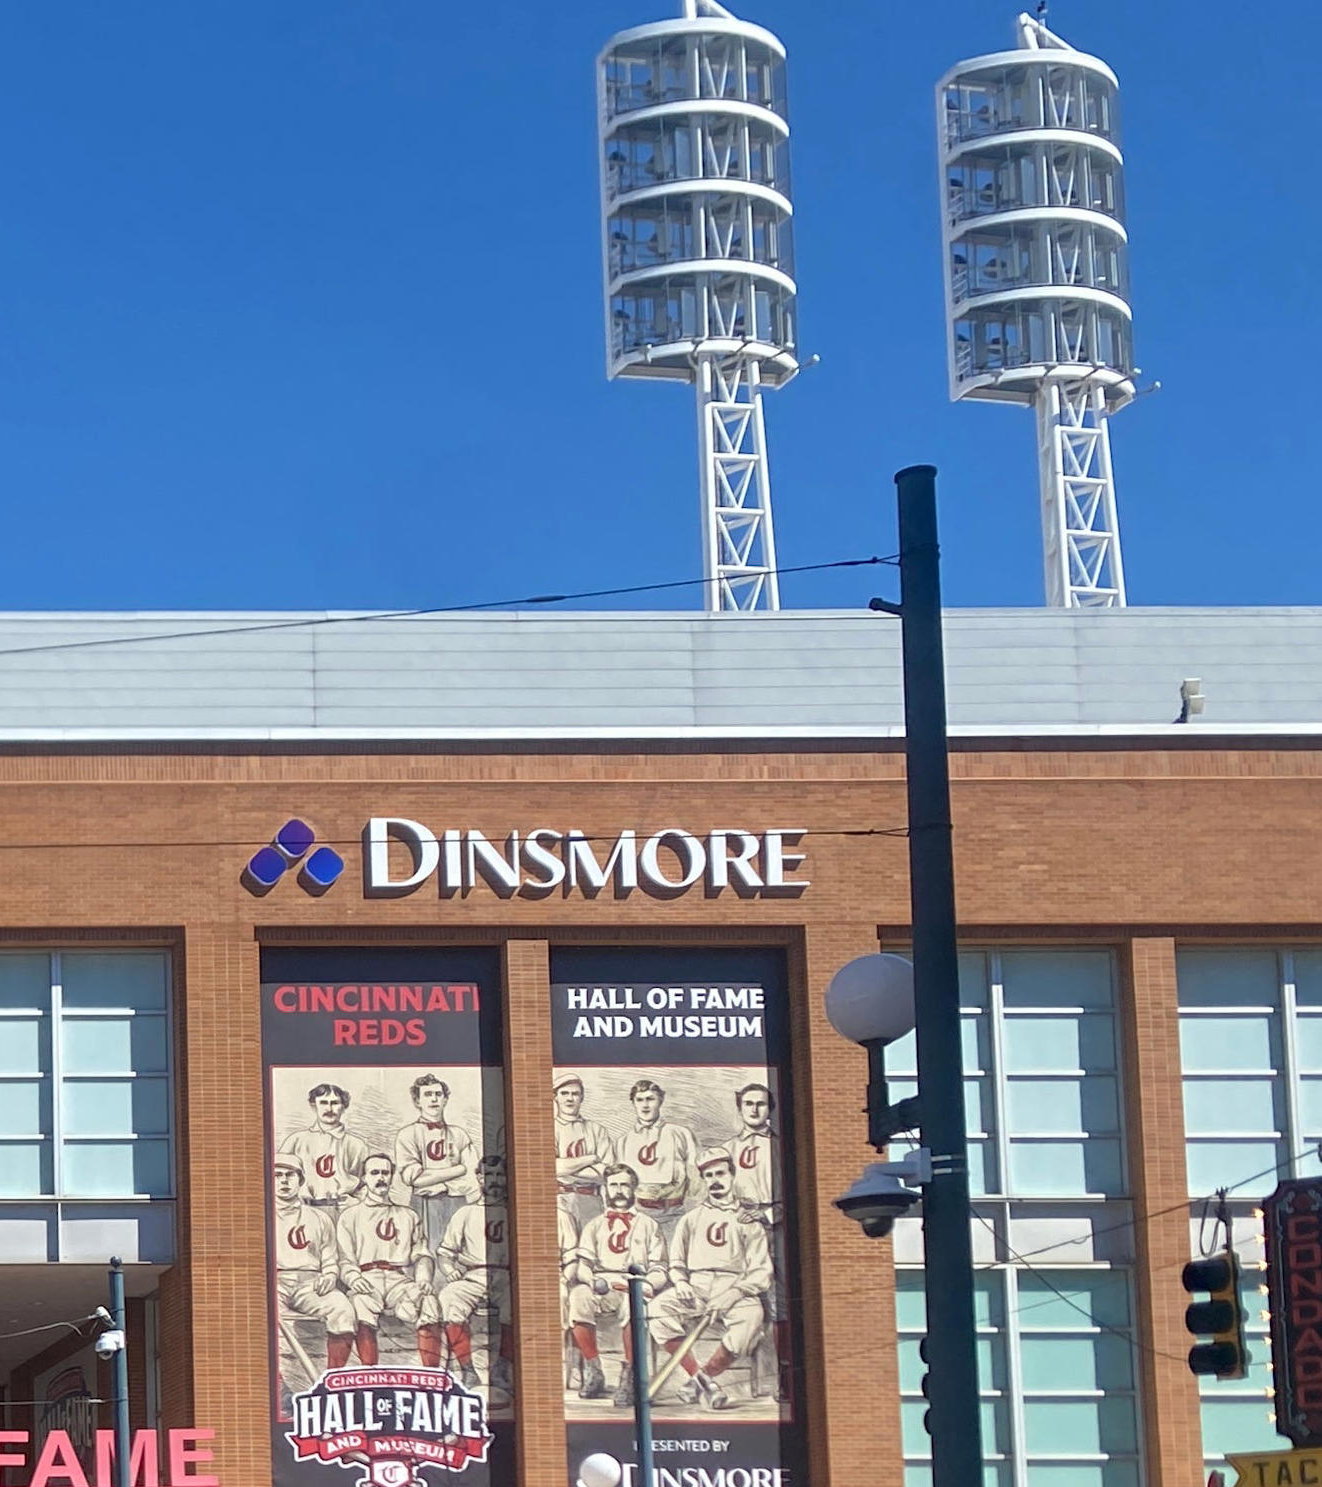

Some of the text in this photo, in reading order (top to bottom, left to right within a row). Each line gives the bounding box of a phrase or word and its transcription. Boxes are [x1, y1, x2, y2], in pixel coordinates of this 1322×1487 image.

[369, 816, 810, 889] DINSMORE
[274, 985, 481, 1013] CINCINNATI
[568, 988, 765, 1010] HALL OF FAME
[334, 1019, 426, 1045] REDS
[573, 1016, 763, 1038] AND MUSEUM
[332, 1373, 445, 1388] CINCINNATI REDS
[299, 1391, 482, 1438] HALL OF FAME
[326, 1436, 456, 1463] AND MUSEUM
[633, 1440, 731, 1453] ESENTED BY
